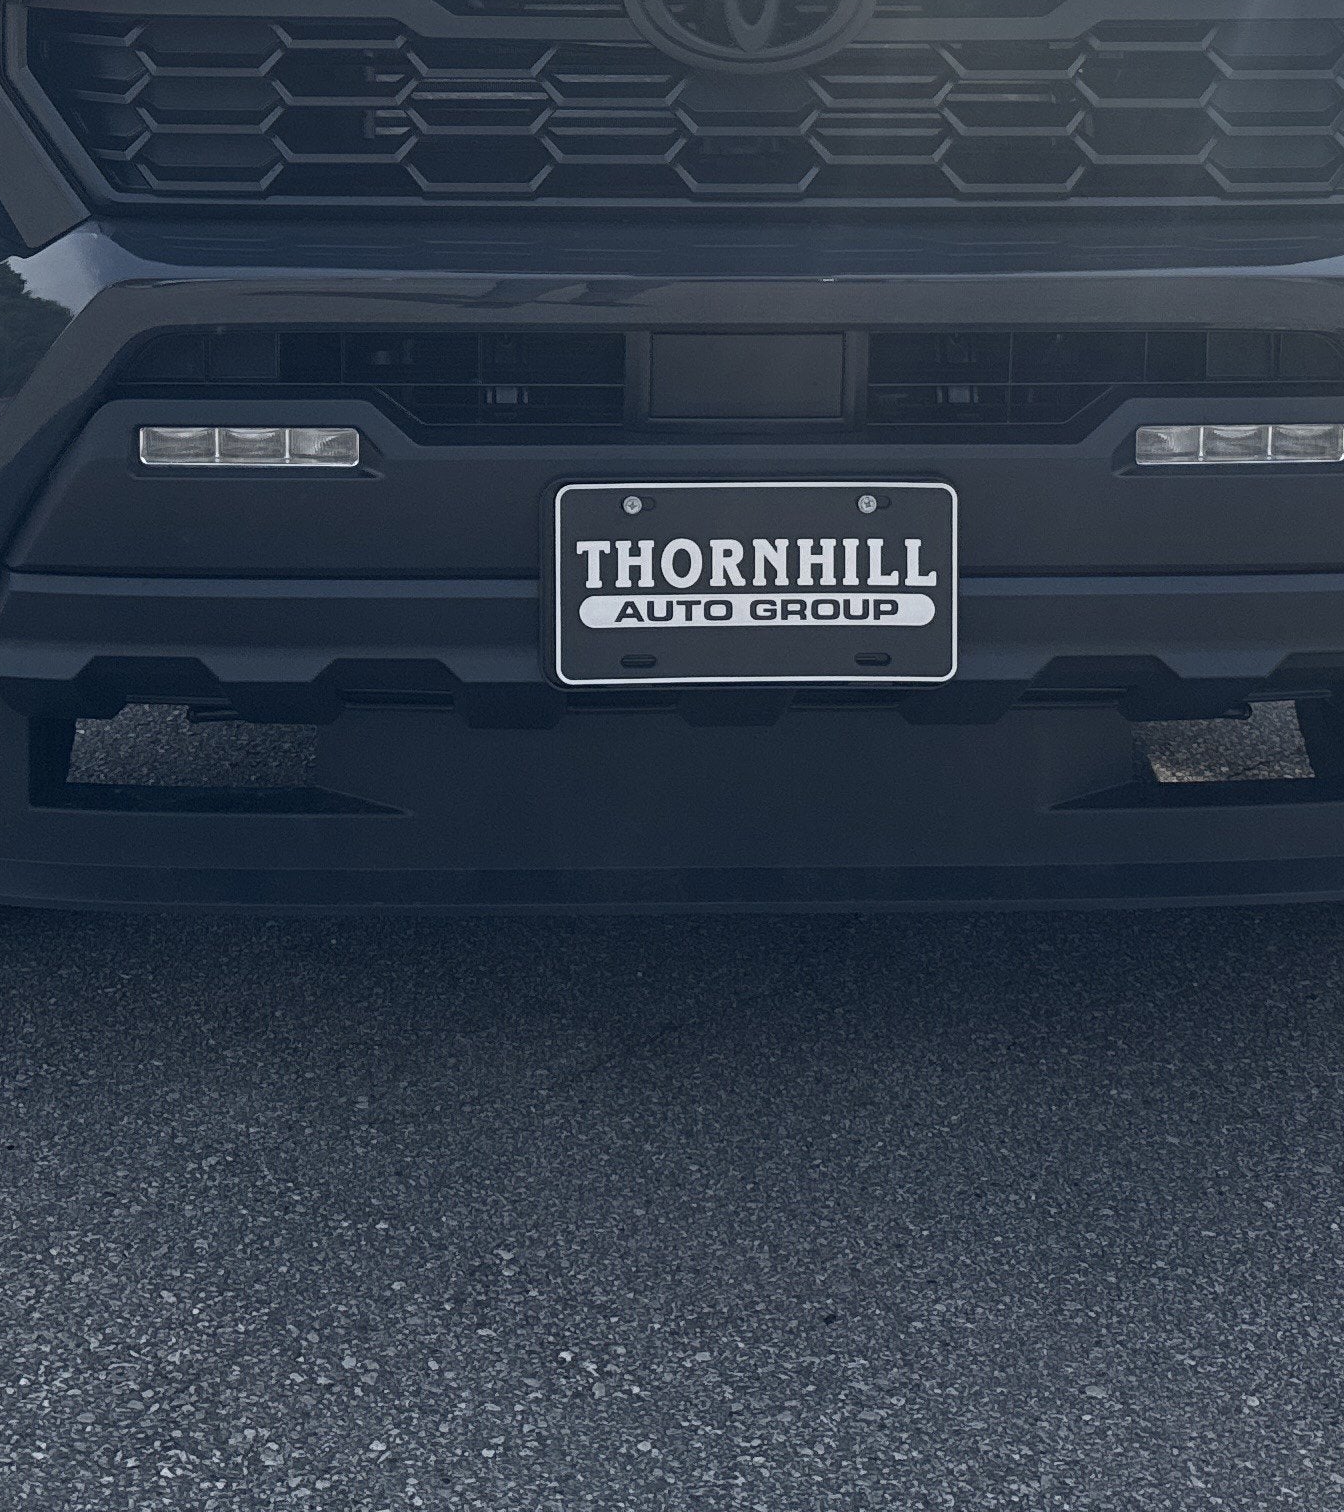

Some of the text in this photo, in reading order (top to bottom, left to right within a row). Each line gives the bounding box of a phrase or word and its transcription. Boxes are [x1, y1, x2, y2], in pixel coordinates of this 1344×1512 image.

[576, 537, 938, 589] THORNHILL
[614, 598, 900, 623] AUTO GROUP
